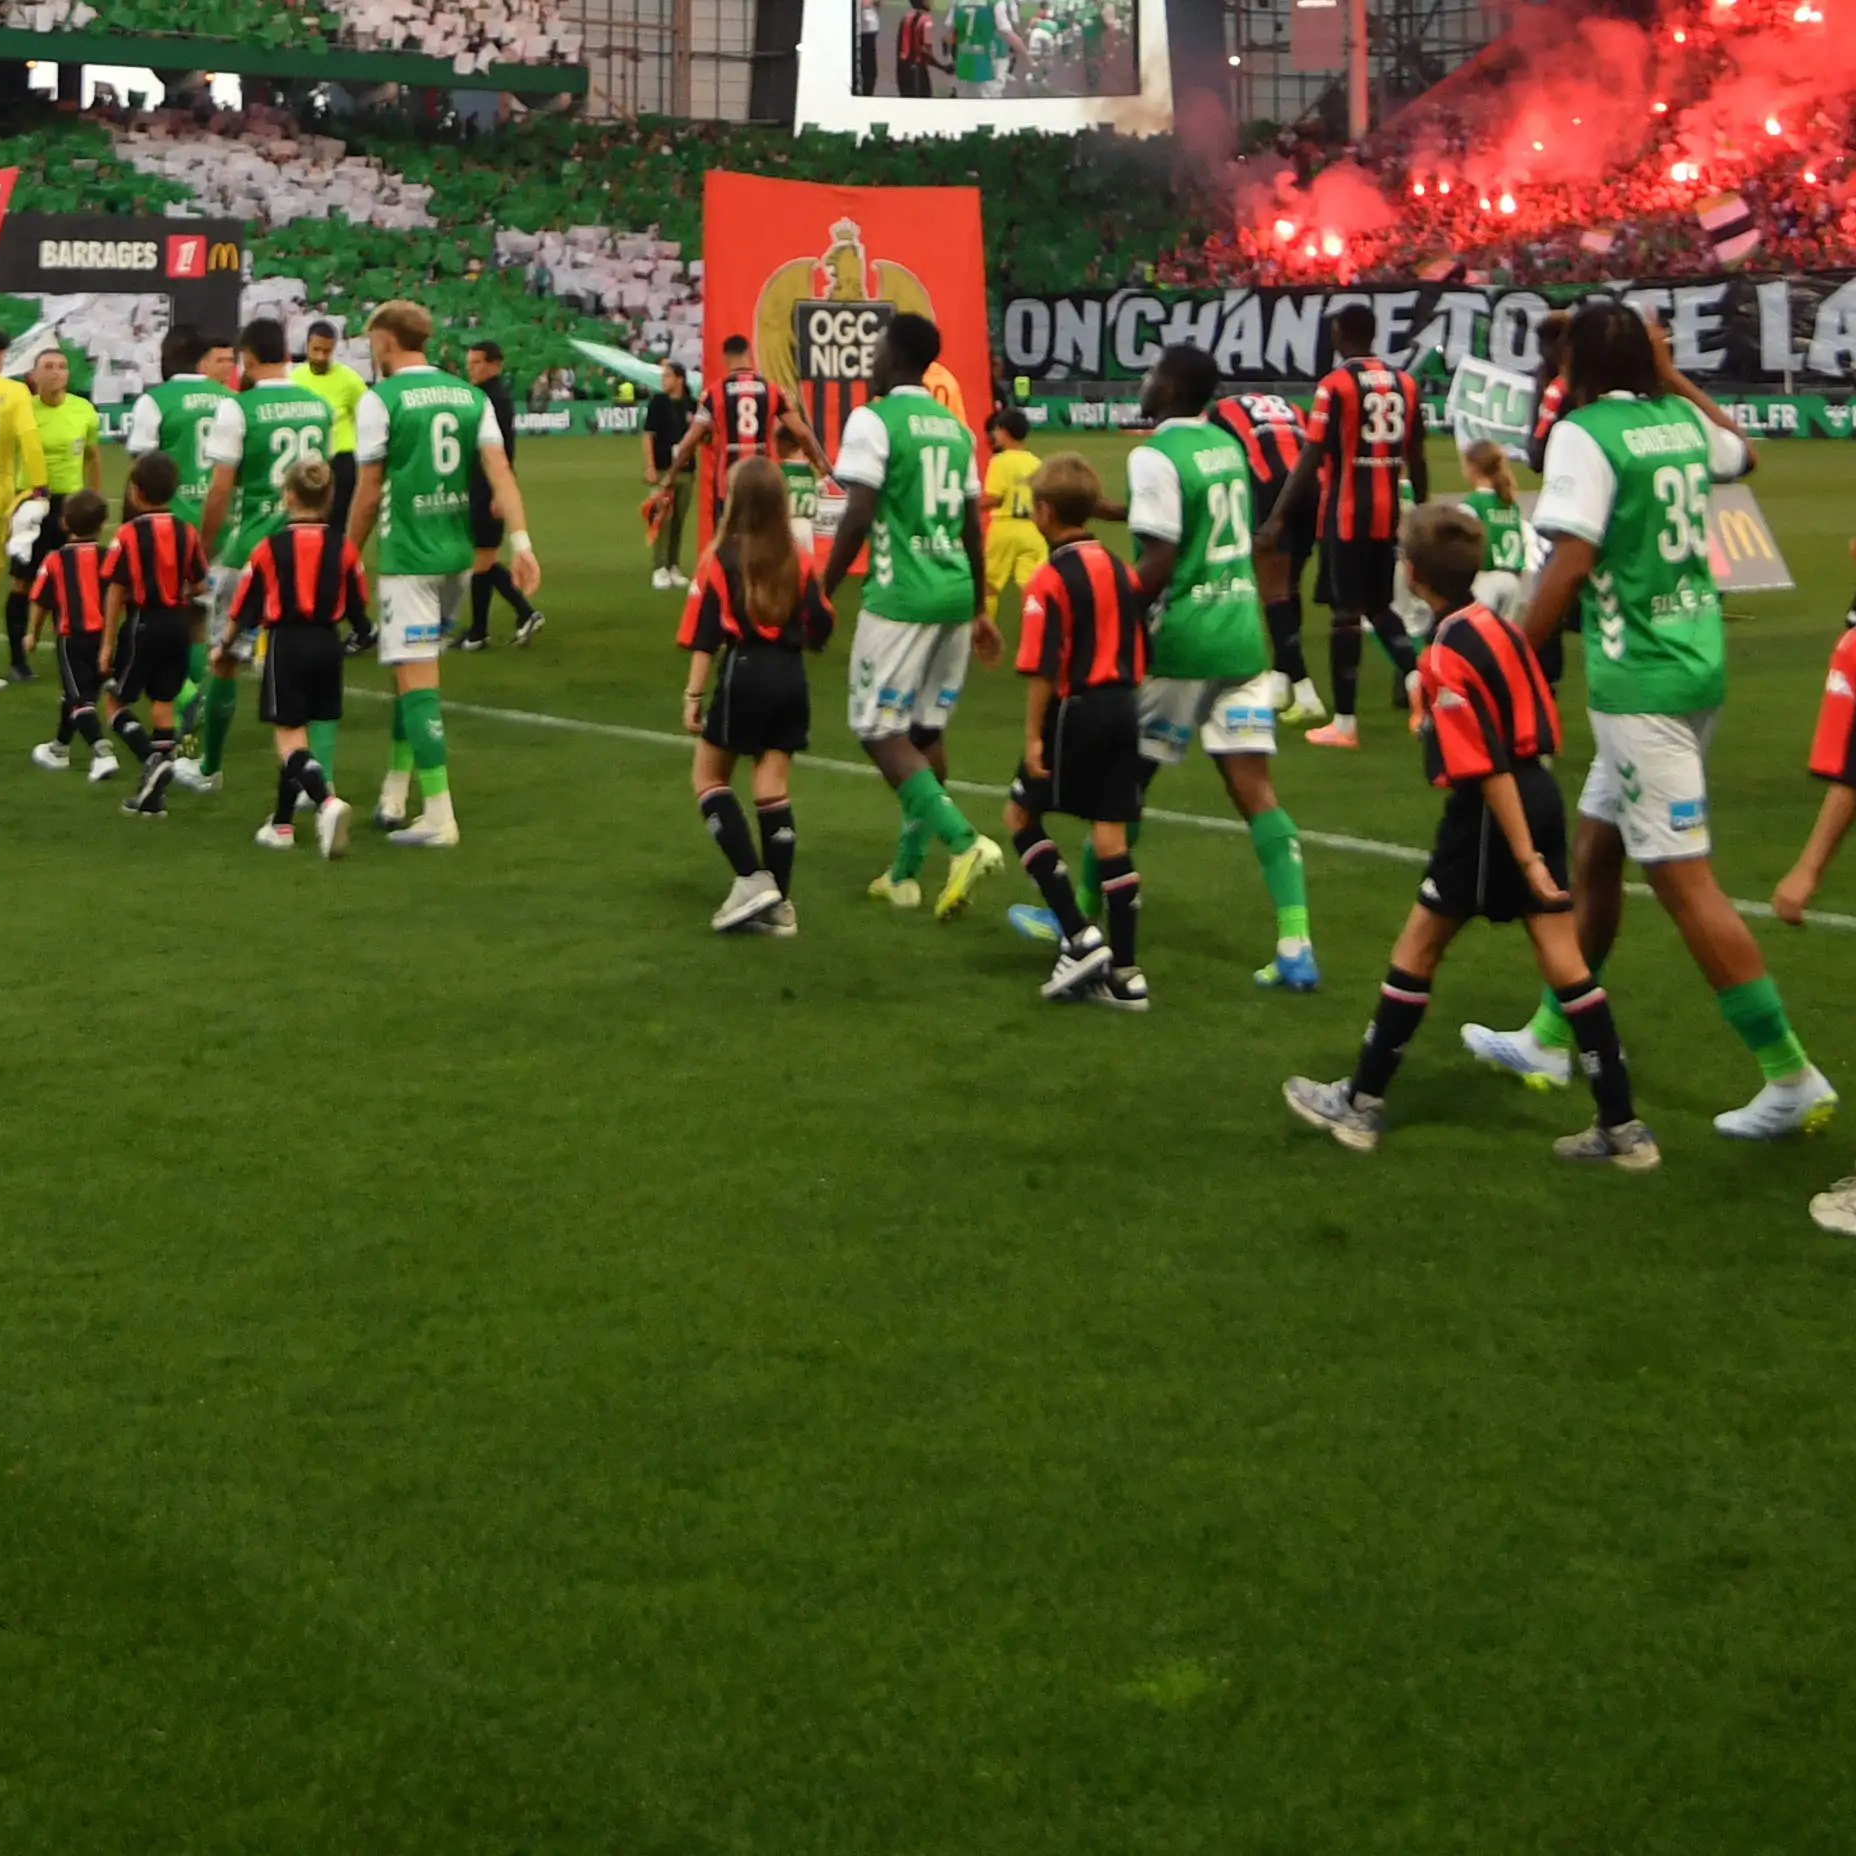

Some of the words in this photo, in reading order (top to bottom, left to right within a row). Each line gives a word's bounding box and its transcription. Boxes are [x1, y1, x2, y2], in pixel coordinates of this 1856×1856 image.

[38, 239, 158, 270] BARRAGES
[809, 310, 879, 344] OGC
[1003, 296, 1101, 377] ON
[811, 345, 873, 378] NICE
[430, 412, 461, 475] 6
[595, 406, 639, 428] VISIT
[737, 396, 759, 436] 8
[1361, 391, 1405, 443] 33
[269, 424, 324, 488] 26
[920, 445, 964, 519] 14
[1206, 477, 1252, 563] 20
[1652, 461, 1709, 563] 35
